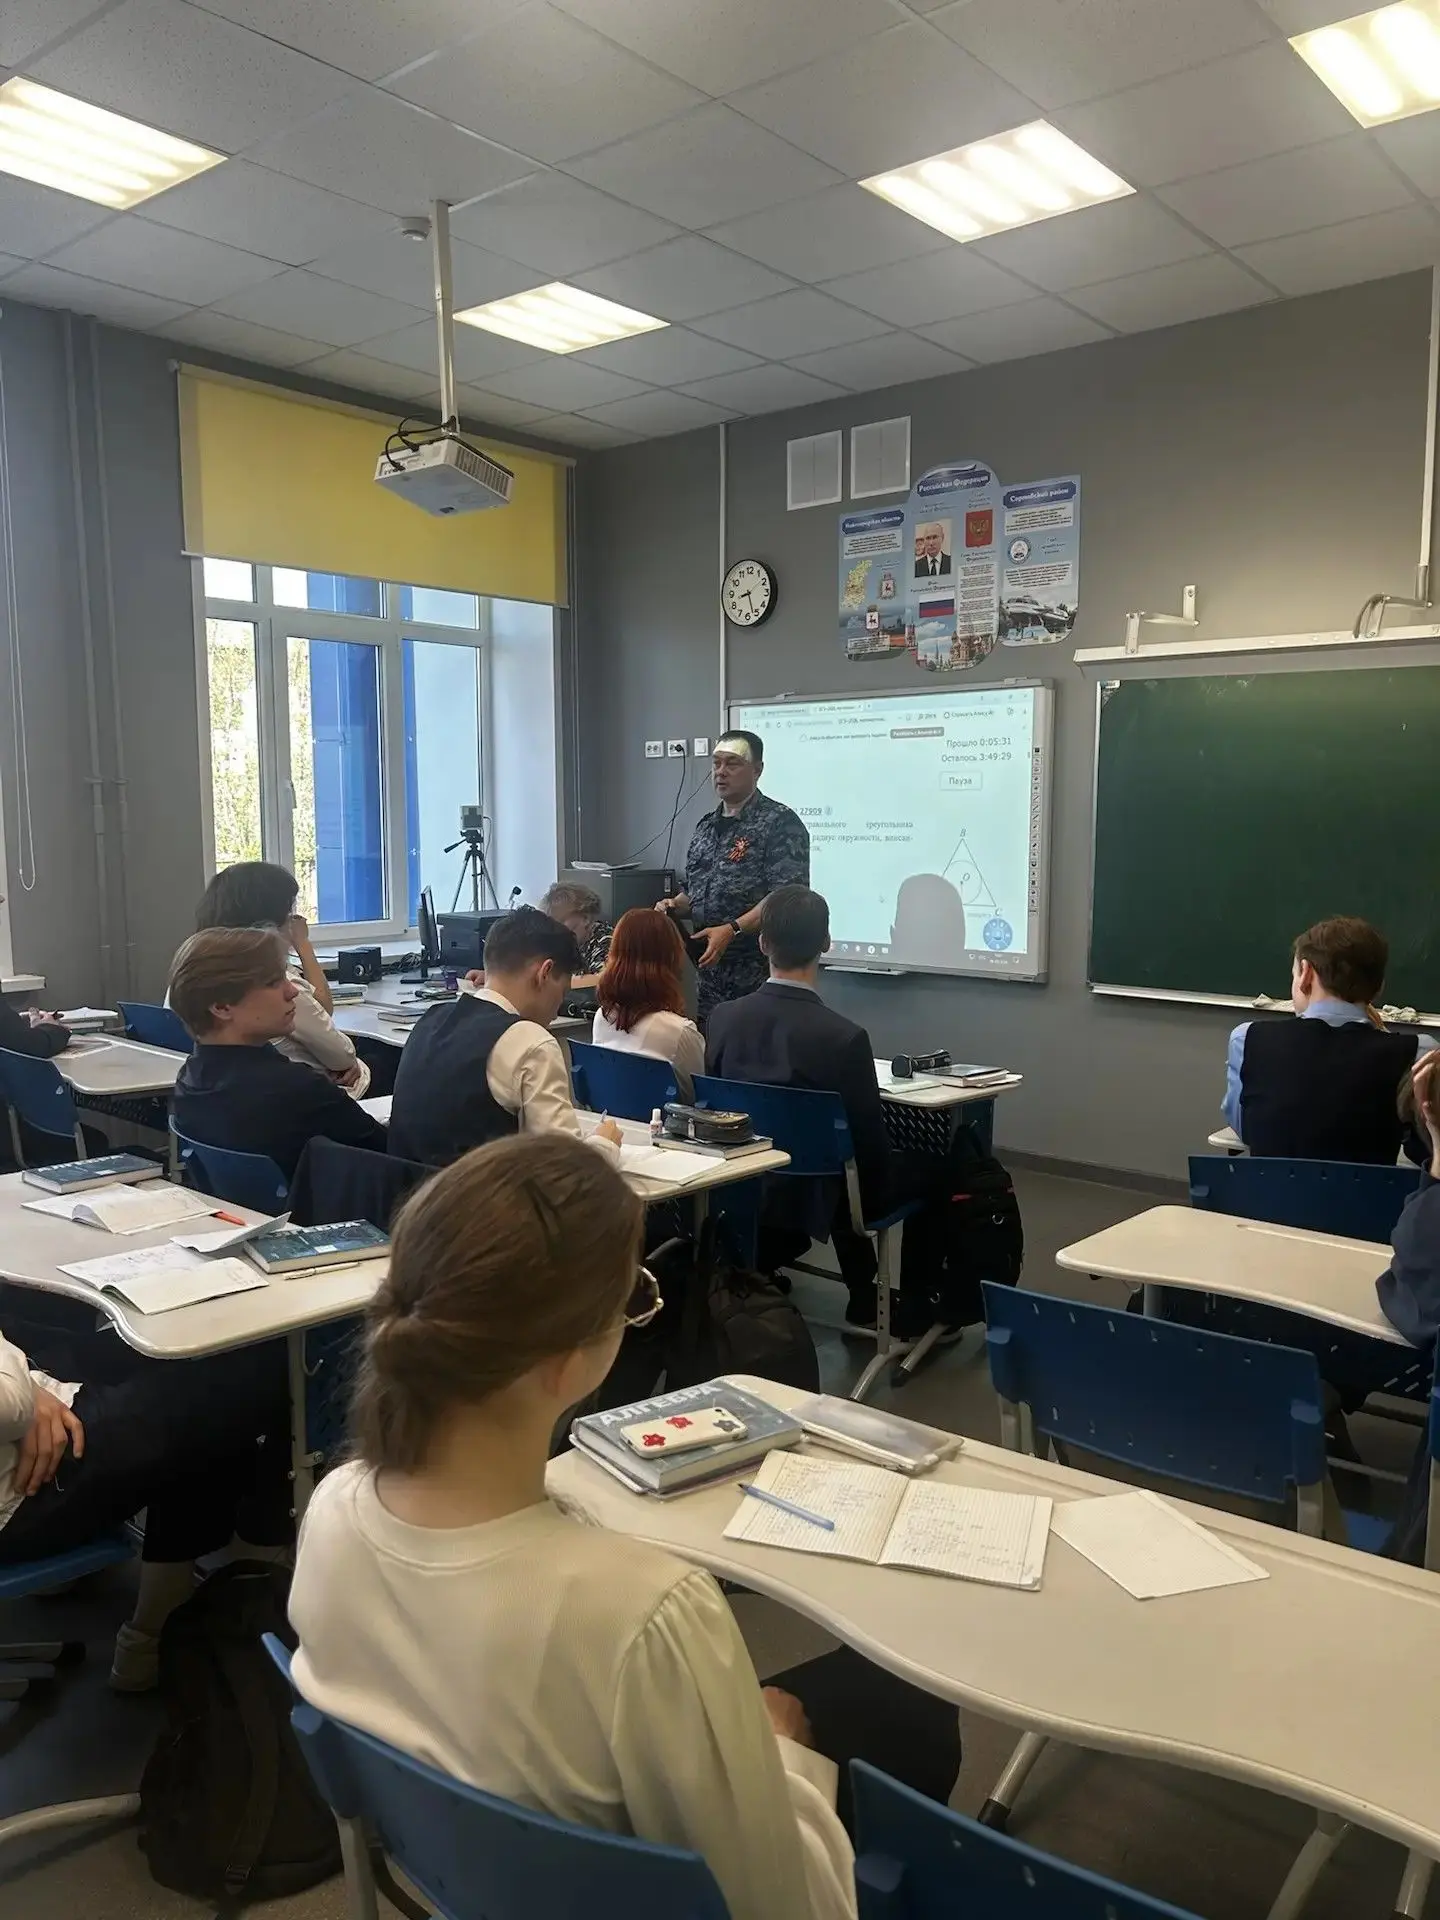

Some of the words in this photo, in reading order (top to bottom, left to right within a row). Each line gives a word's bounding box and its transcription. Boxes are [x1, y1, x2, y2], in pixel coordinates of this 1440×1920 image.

[739, 570, 745, 578] 11
[746, 566, 754, 575] 12
[732, 579, 740, 587] 10
[761, 577, 767, 586] 2
[729, 590, 735, 598] 9
[763, 588, 770, 597] 3
[731, 601, 737, 610] 8
[738, 609, 743, 617] 7
[745, 612, 751, 620] 6
[754, 609, 760, 617] 5
[946, 739, 978, 749] Прошло
[980, 737, 1012, 747] 0:05:31
[941, 754, 978, 763] Осталось
[980, 752, 1012, 761] 3:49:29
[949, 776, 973, 788] Пауза
[600, 1382, 724, 1427] АЛГЕБРА
